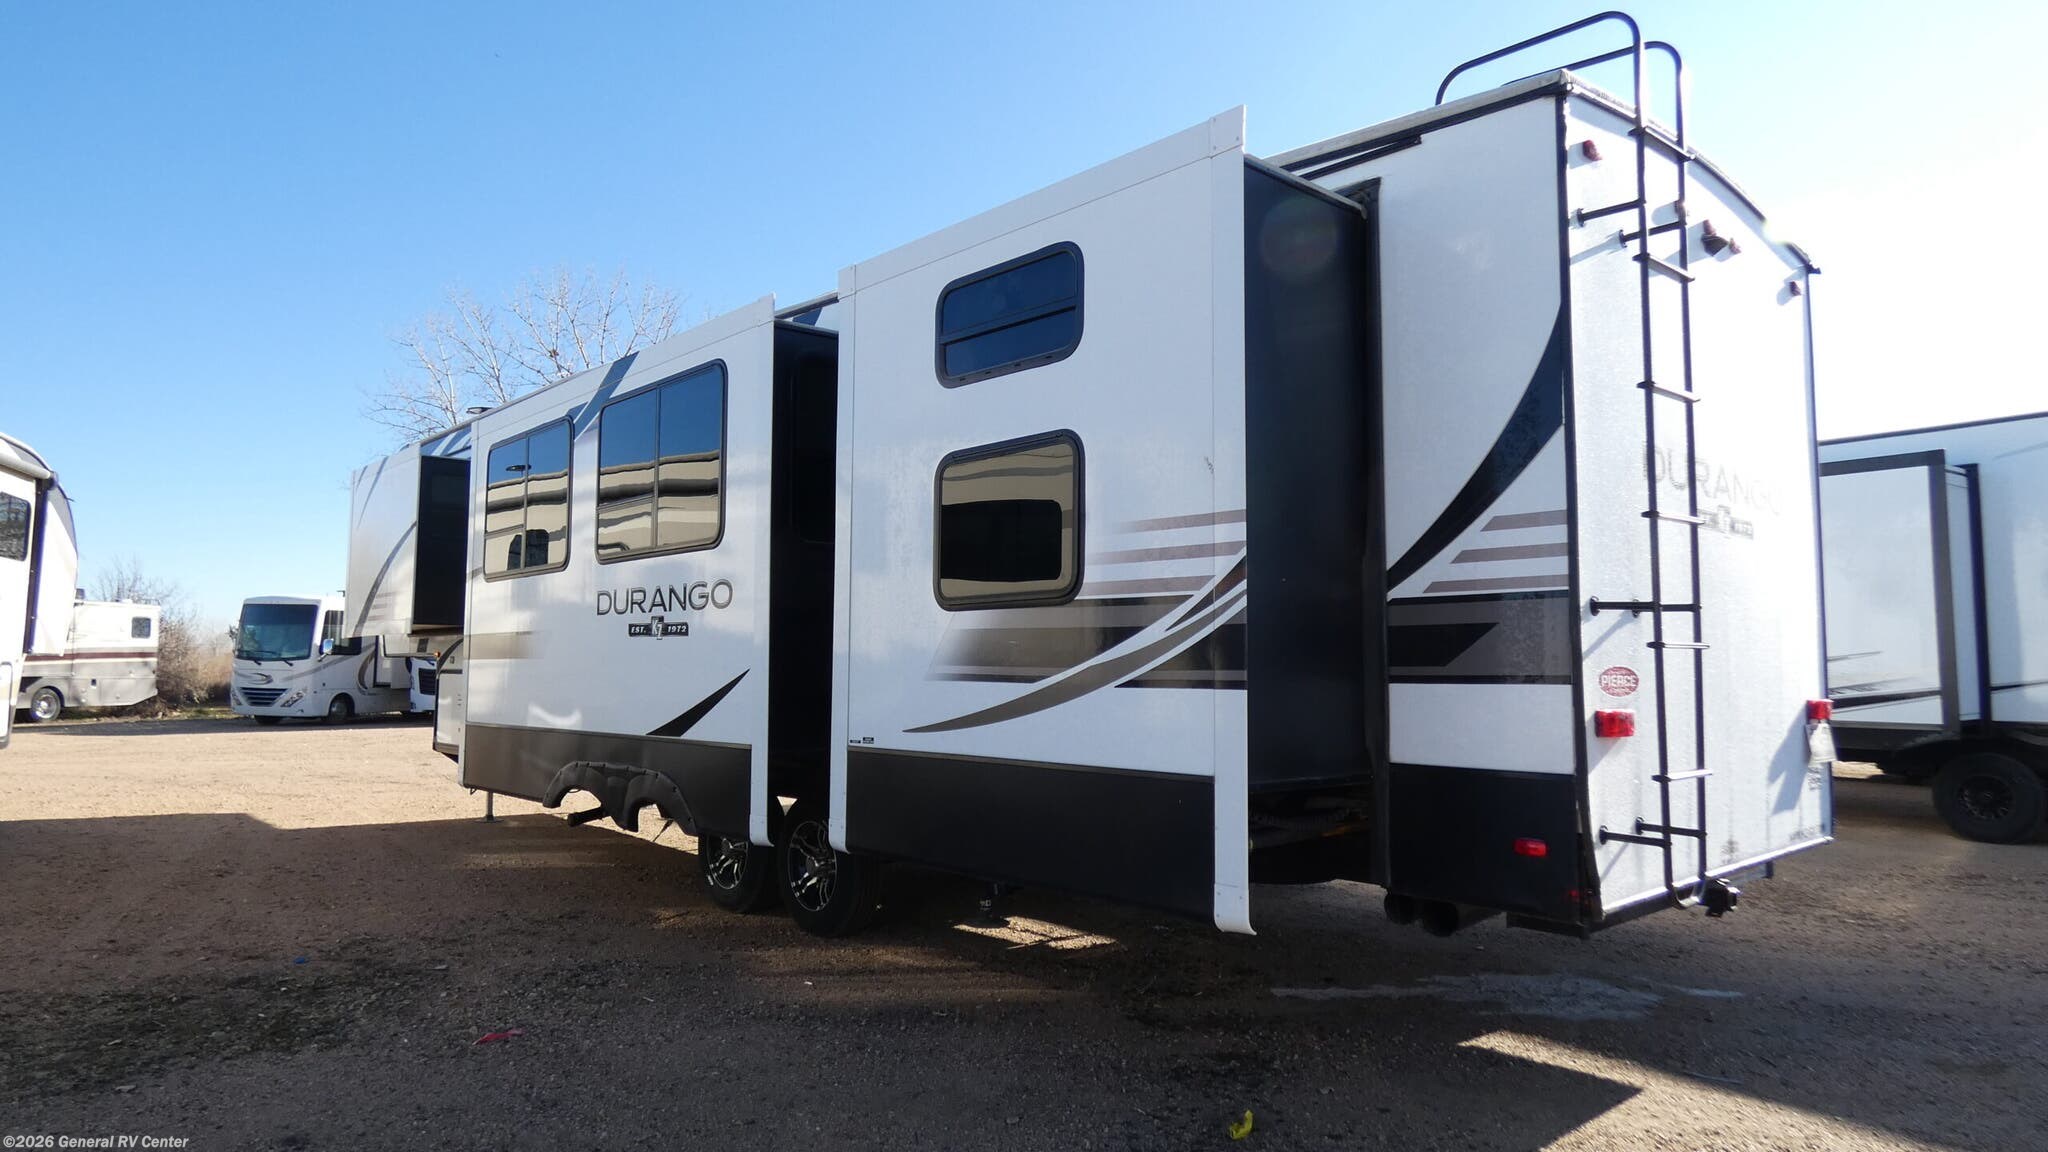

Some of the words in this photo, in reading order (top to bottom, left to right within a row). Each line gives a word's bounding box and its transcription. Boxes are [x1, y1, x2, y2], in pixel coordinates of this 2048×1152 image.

[596, 578, 733, 616] DURANGO
[630, 625, 647, 634] EST.
[667, 624, 687, 634] 1972
